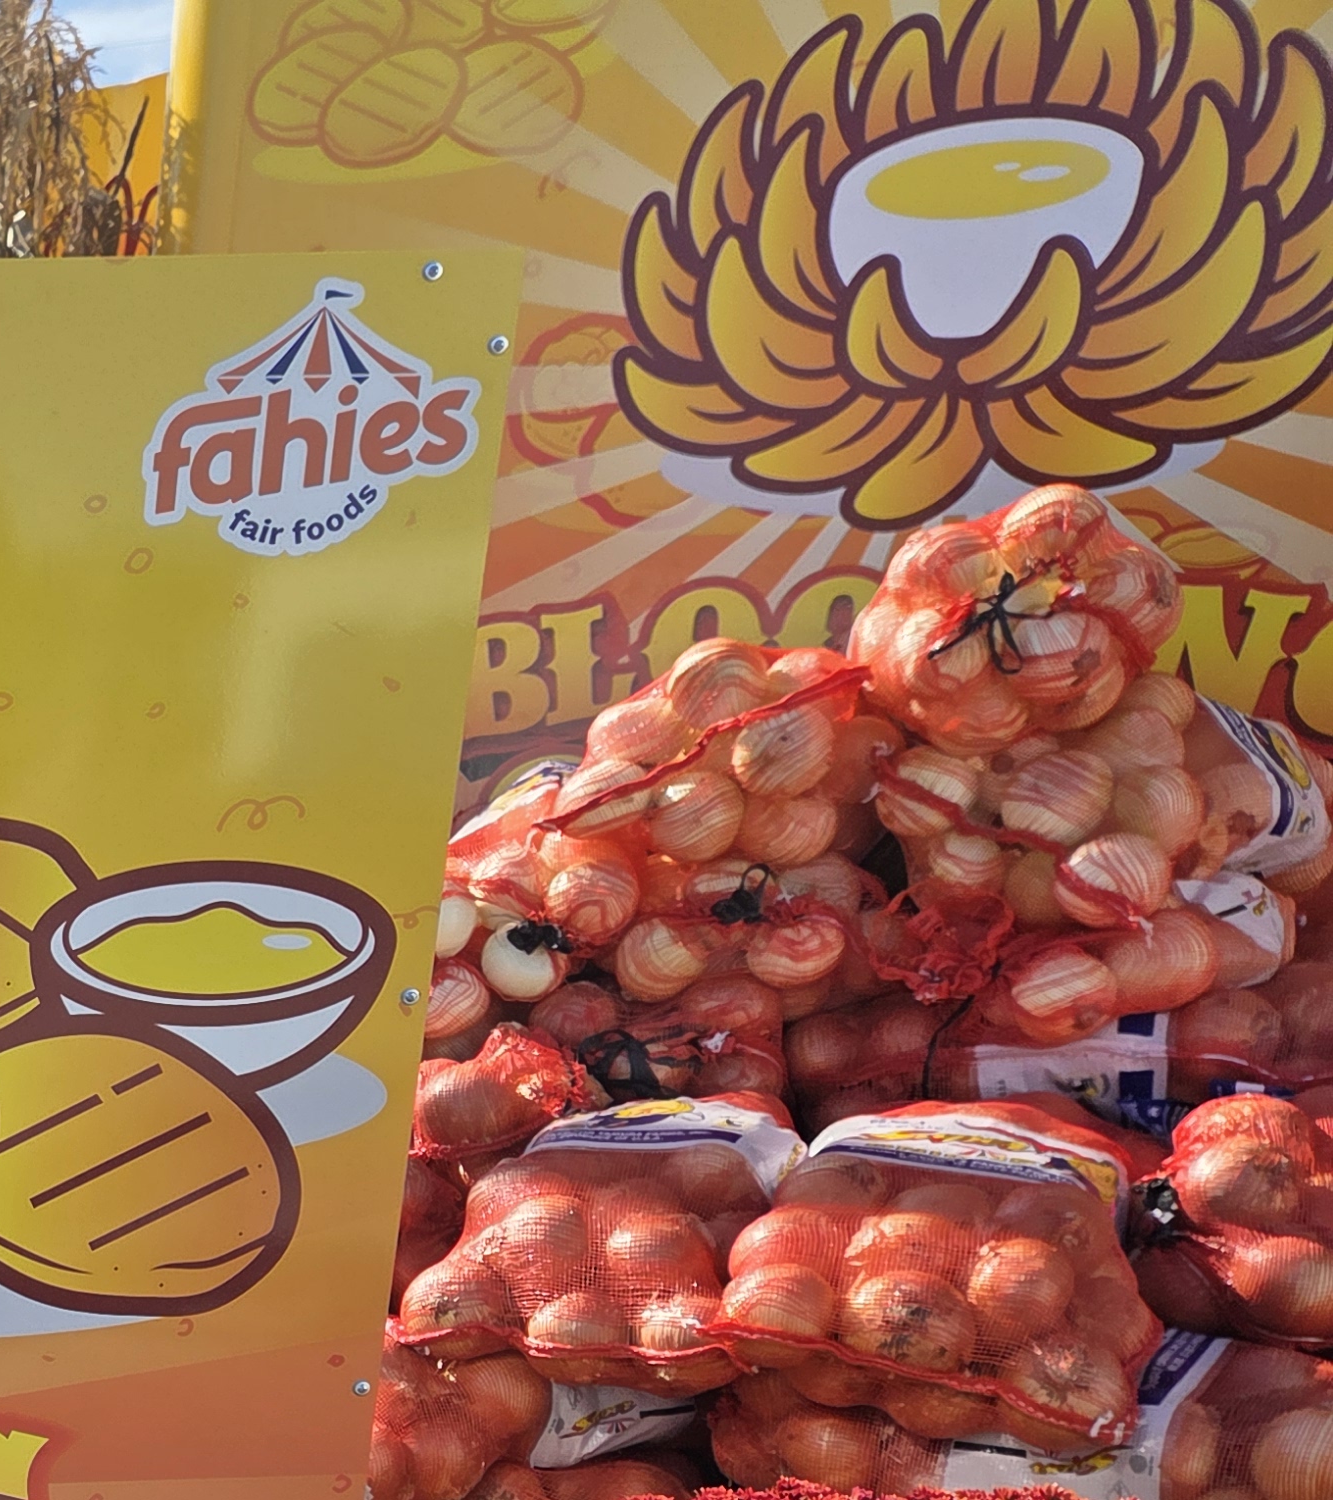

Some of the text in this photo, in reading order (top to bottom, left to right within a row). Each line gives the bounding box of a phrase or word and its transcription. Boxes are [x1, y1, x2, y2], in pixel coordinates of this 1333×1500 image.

[152, 383, 471, 515] fahies
[228, 483, 378, 545] fair foods
